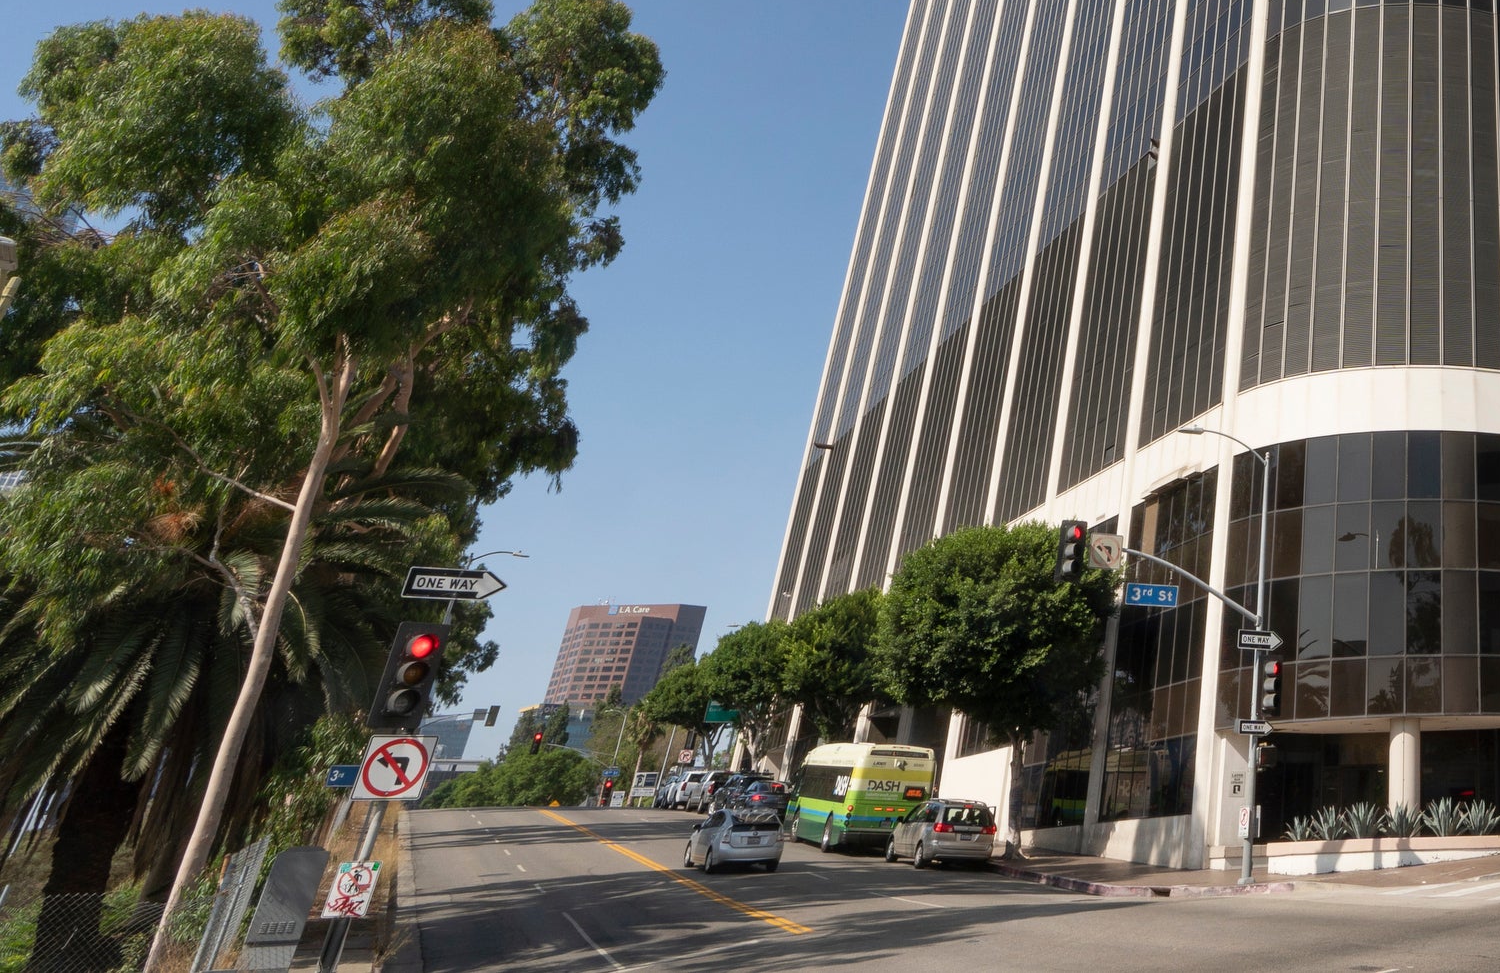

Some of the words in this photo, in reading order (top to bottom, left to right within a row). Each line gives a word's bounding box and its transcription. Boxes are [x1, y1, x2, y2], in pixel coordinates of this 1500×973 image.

[416, 577, 445, 589] ONE
[449, 579, 478, 590] WAY
[1131, 587, 1153, 601] 3rd
[1158, 590, 1173, 602] St
[633, 605, 650, 614] Care
[1243, 635, 1256, 644] ONE
[1257, 637, 1270, 645] WAY
[867, 780, 901, 792] DASH
